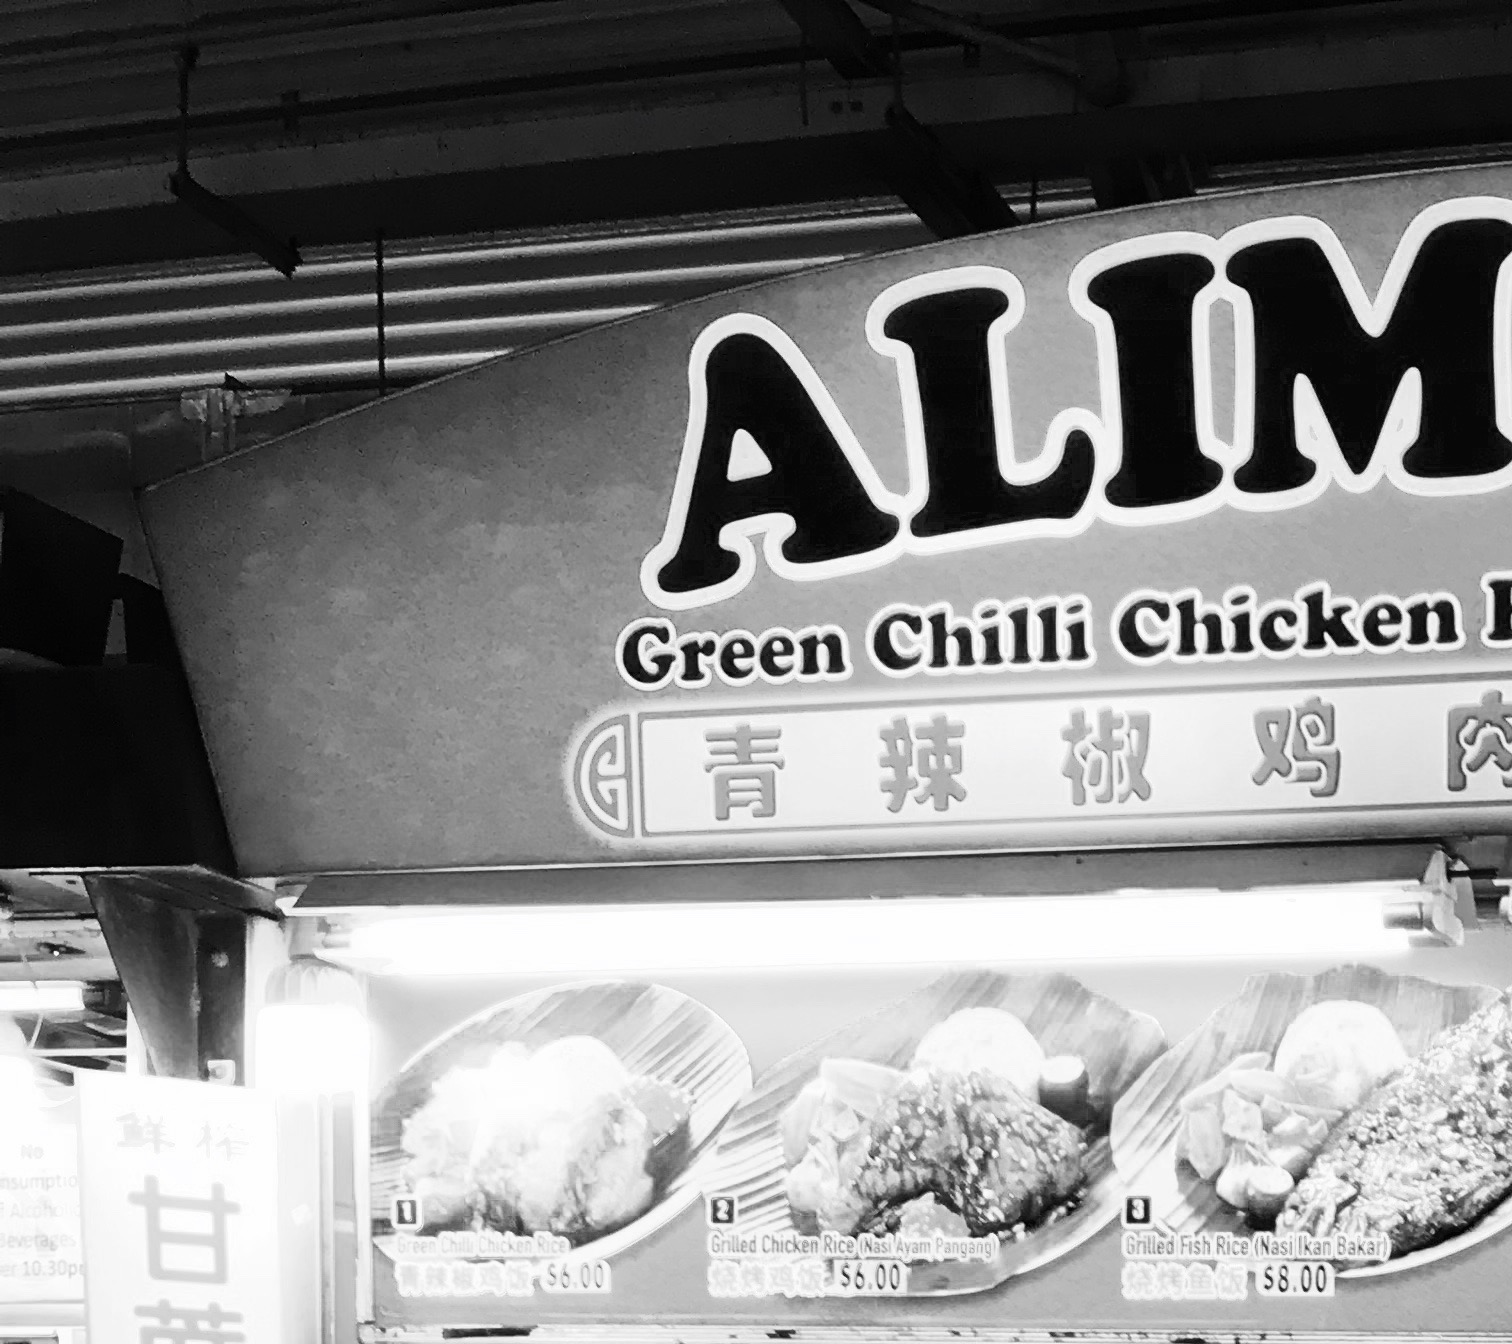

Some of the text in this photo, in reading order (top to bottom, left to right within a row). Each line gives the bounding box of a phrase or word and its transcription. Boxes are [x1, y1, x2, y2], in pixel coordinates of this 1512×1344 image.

[620, 622, 844, 686] Green
[872, 602, 1090, 671] Chilli
[1117, 583, 1457, 658] Chicken
[396, 1234, 568, 1254] Green Chilli Chicken Rice
[711, 1235, 757, 1254] Grilled
[762, 1235, 818, 1255] Chicken
[824, 1235, 855, 1255] Rice
[859, 1235, 893, 1256] (Nasi
[898, 1238, 932, 1258] Ayam
[1126, 1234, 1389, 1259] Grilled Fish Rice (Nasi Ikan Bakar)
[547, 1262, 603, 1289] $6.00
[840, 1262, 900, 1290] $6.00
[1263, 1264, 1327, 1293] $8.00
